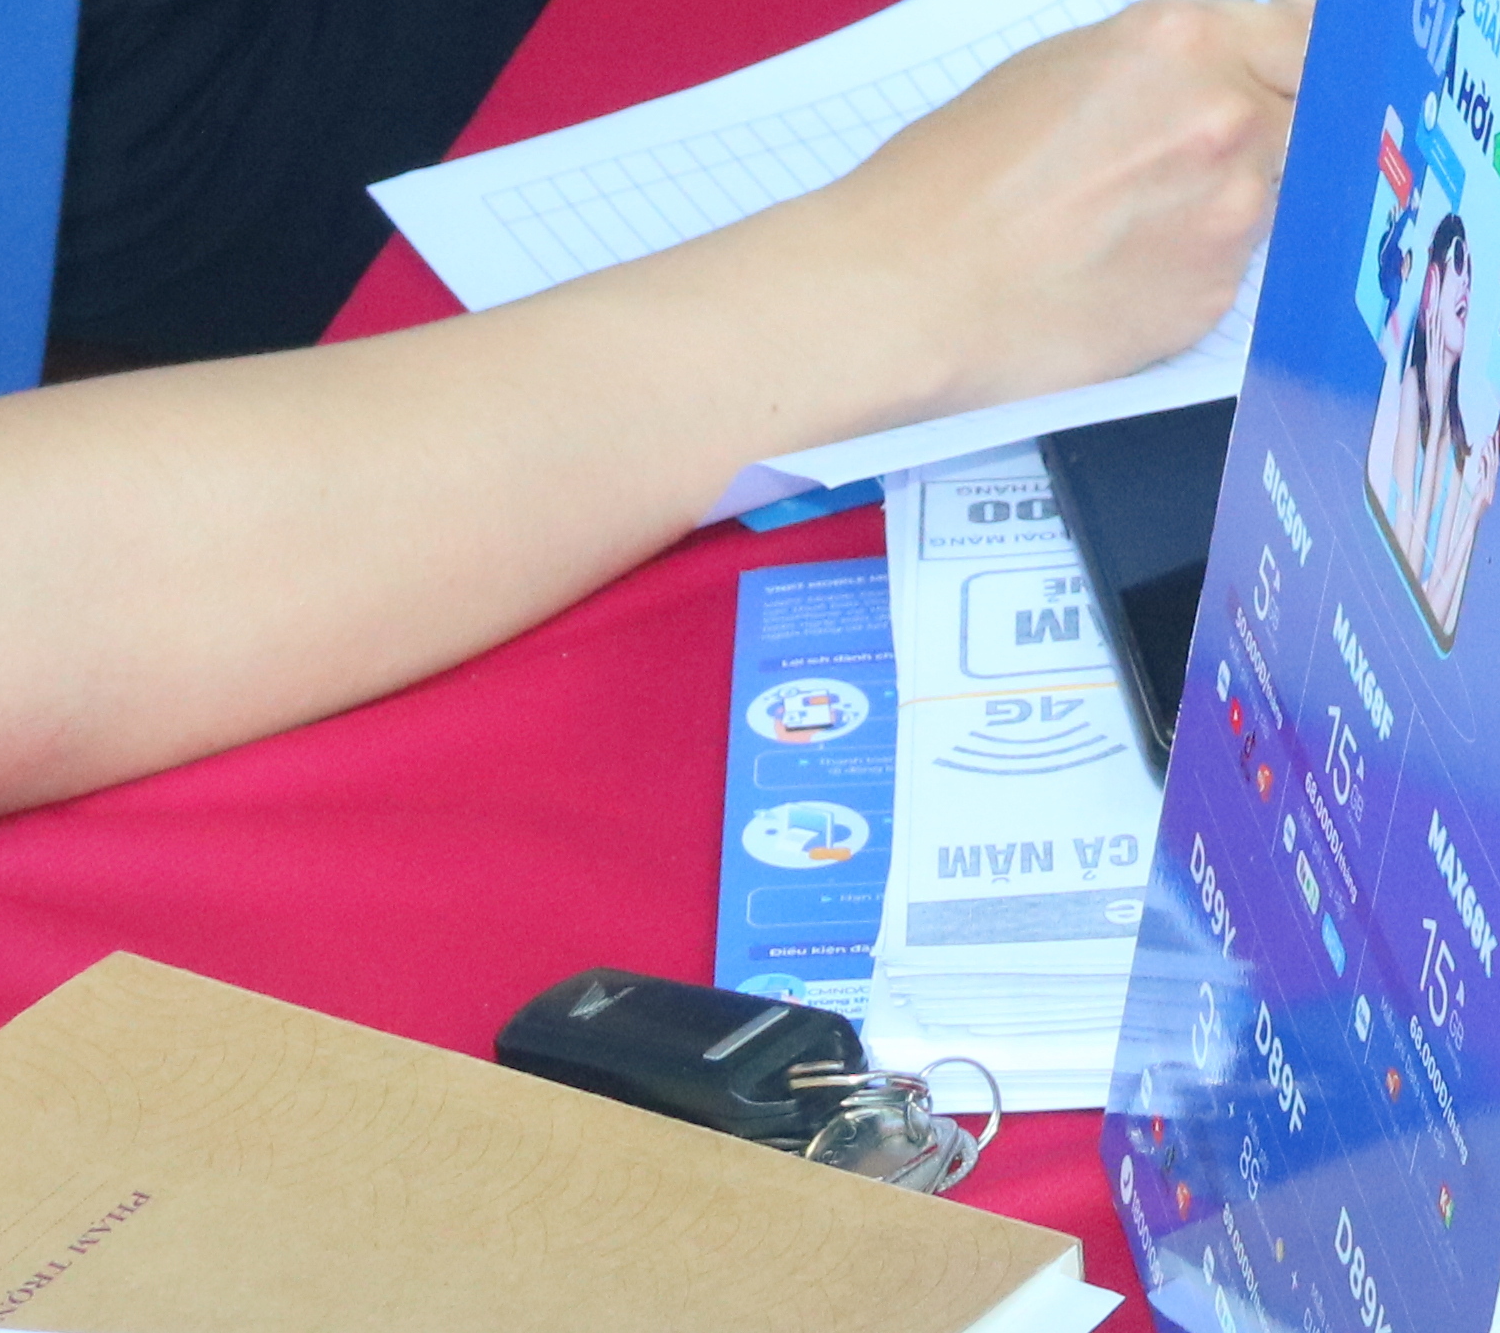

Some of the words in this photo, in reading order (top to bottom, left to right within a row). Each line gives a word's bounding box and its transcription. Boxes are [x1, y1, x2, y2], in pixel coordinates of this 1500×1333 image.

[1457, 68, 1494, 155] HỜI
[1263, 449, 1313, 568] BIG50Y
[985, 695, 1085, 727] 4G
[1332, 602, 1394, 741] MAX68F
[937, 840, 1054, 884] NĂM
[1073, 834, 1139, 881] CẢ
[1190, 832, 1236, 958] D89Y
[1427, 808, 1498, 978] MAX68K
[1255, 1000, 1306, 1133] D89F
[1409, 1015, 1468, 1165] 68.000Đ/tháng
[68, 1190, 150, 1254] PHẠM
